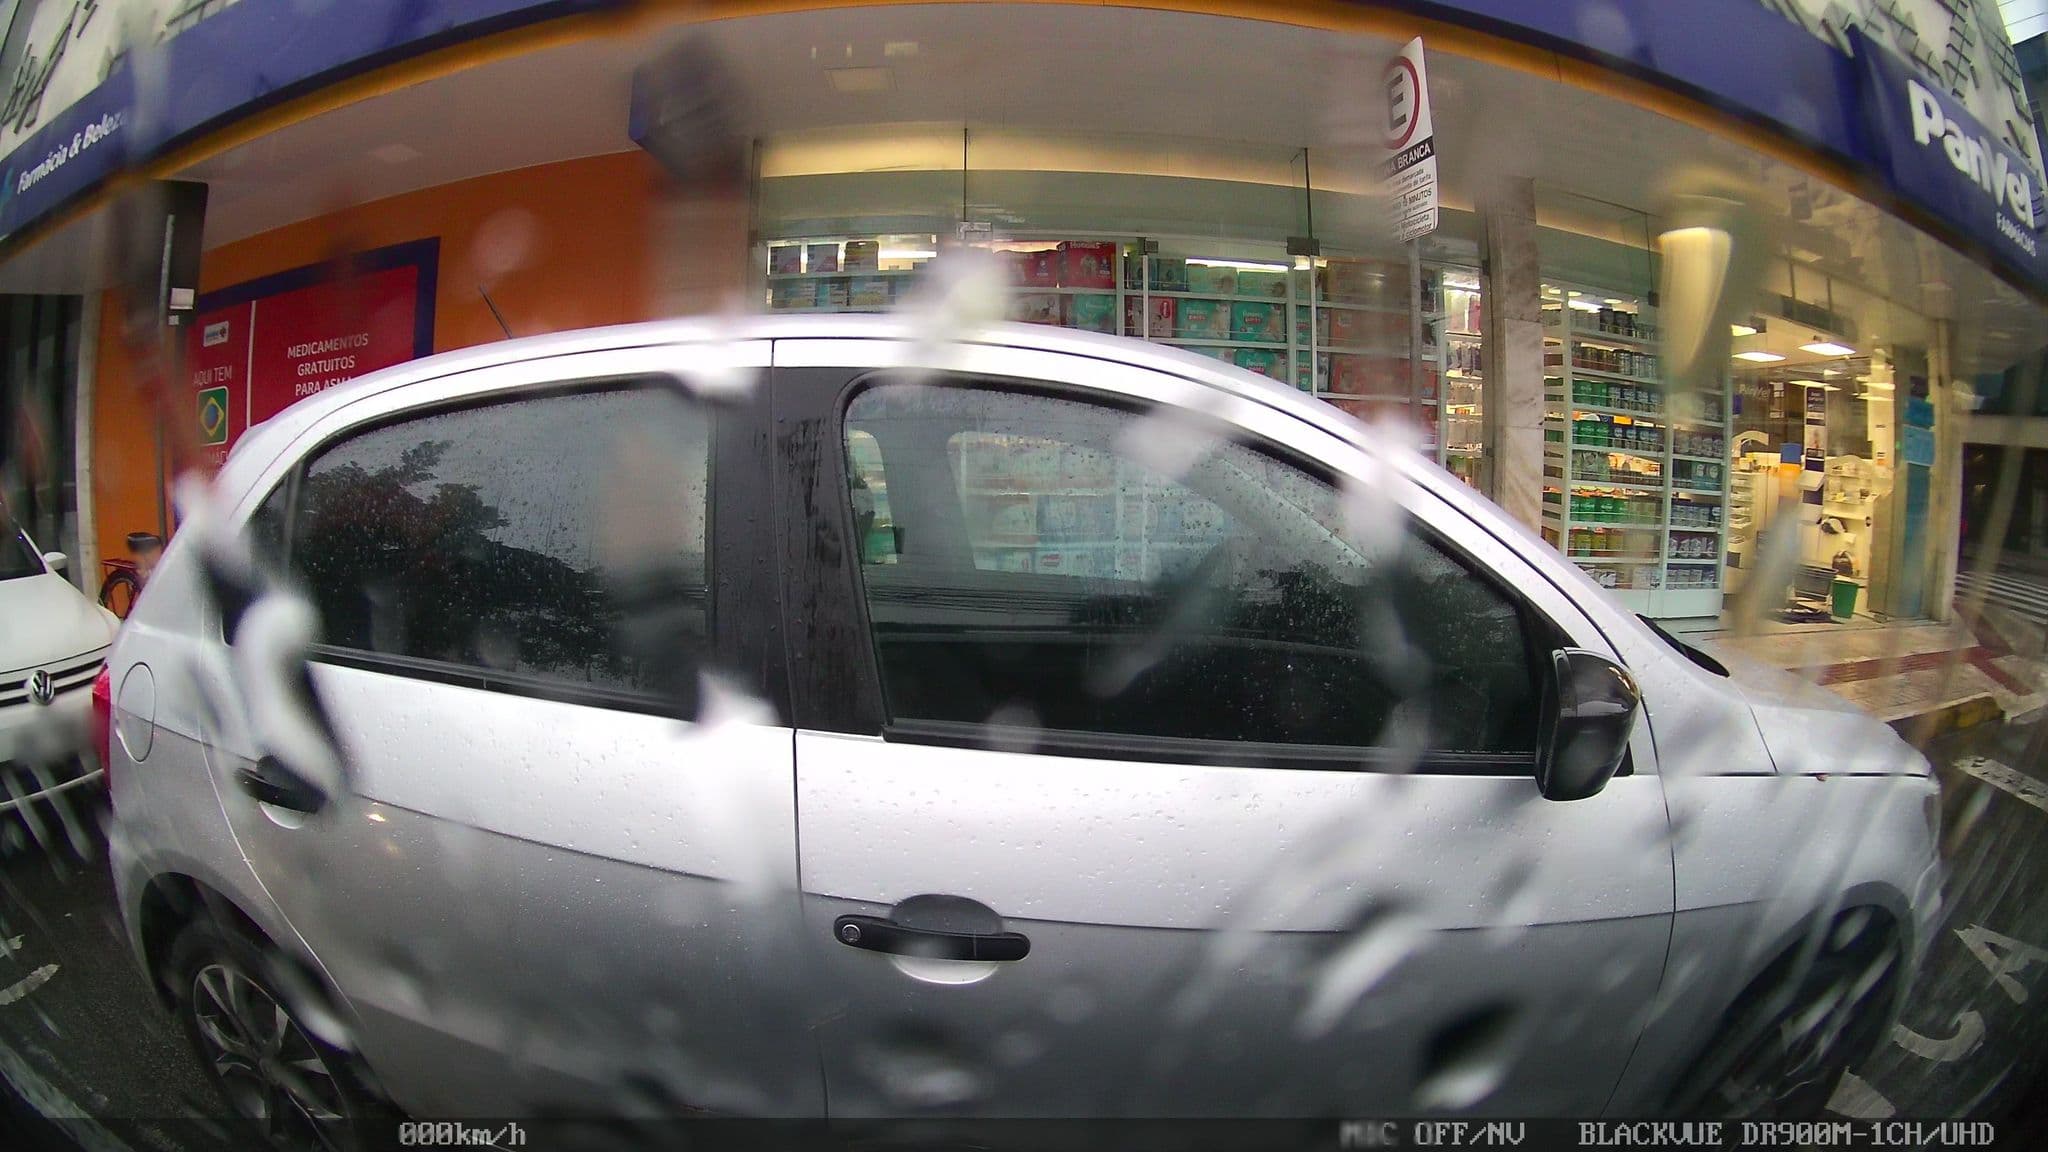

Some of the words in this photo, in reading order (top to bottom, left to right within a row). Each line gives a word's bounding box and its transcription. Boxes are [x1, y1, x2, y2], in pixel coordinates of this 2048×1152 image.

[17, 144, 68, 195] Farmácia
[69, 132, 82, 159] &
[1398, 141, 1432, 170] BRANCA
[287, 332, 369, 359] MEDICAMENTOS
[214, 364, 232, 383] TEM
[297, 355, 356, 377] GRATUITOS
[295, 380, 322, 397] PARA
